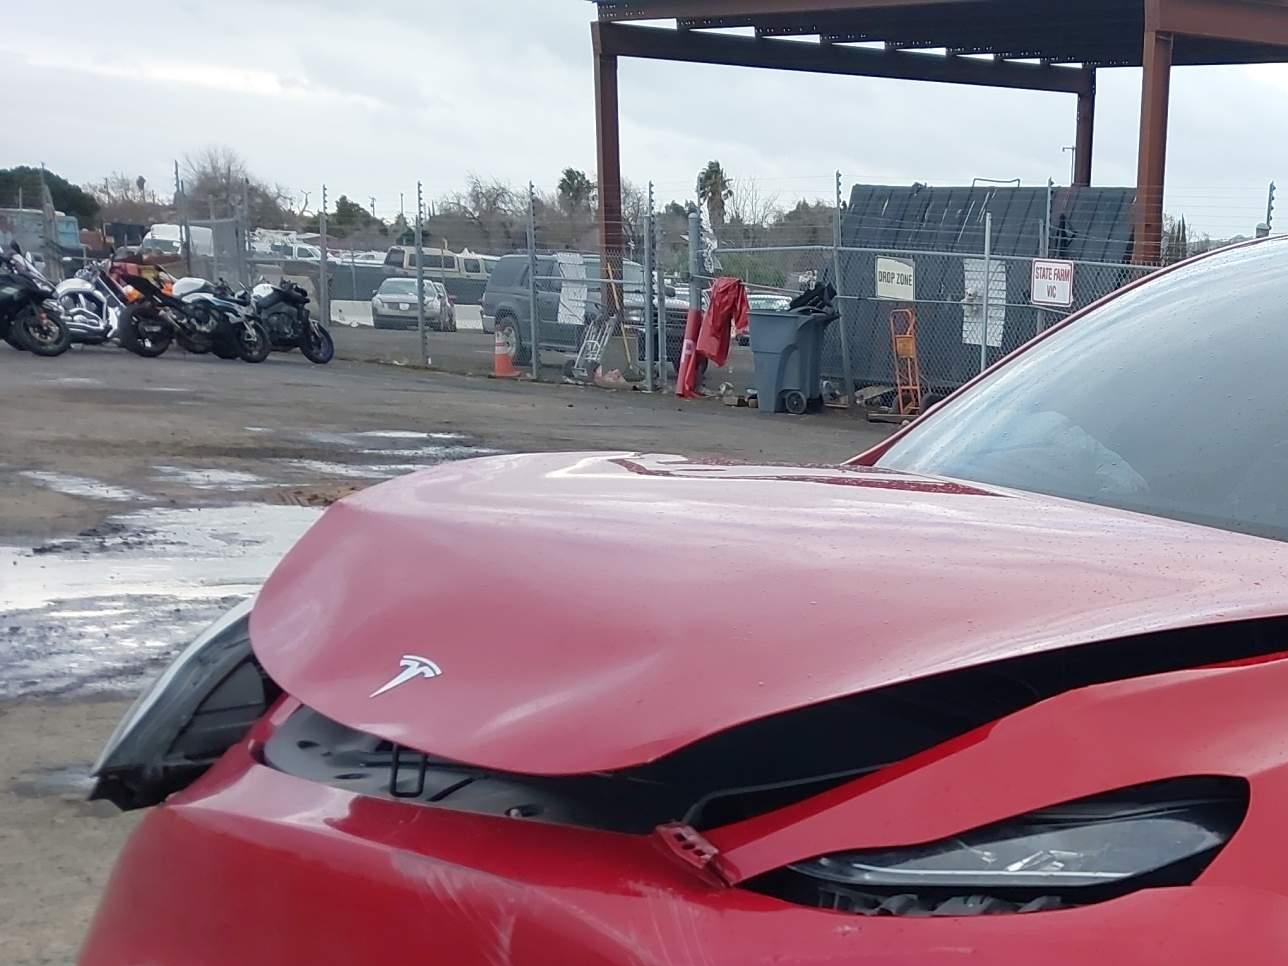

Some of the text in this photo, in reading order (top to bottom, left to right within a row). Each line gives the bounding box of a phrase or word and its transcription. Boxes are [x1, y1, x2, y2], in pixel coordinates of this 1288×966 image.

[878, 270, 912, 287] DROP ZONE
[1035, 266, 1071, 282] STATE FARM
[1046, 284, 1057, 299] VIC
